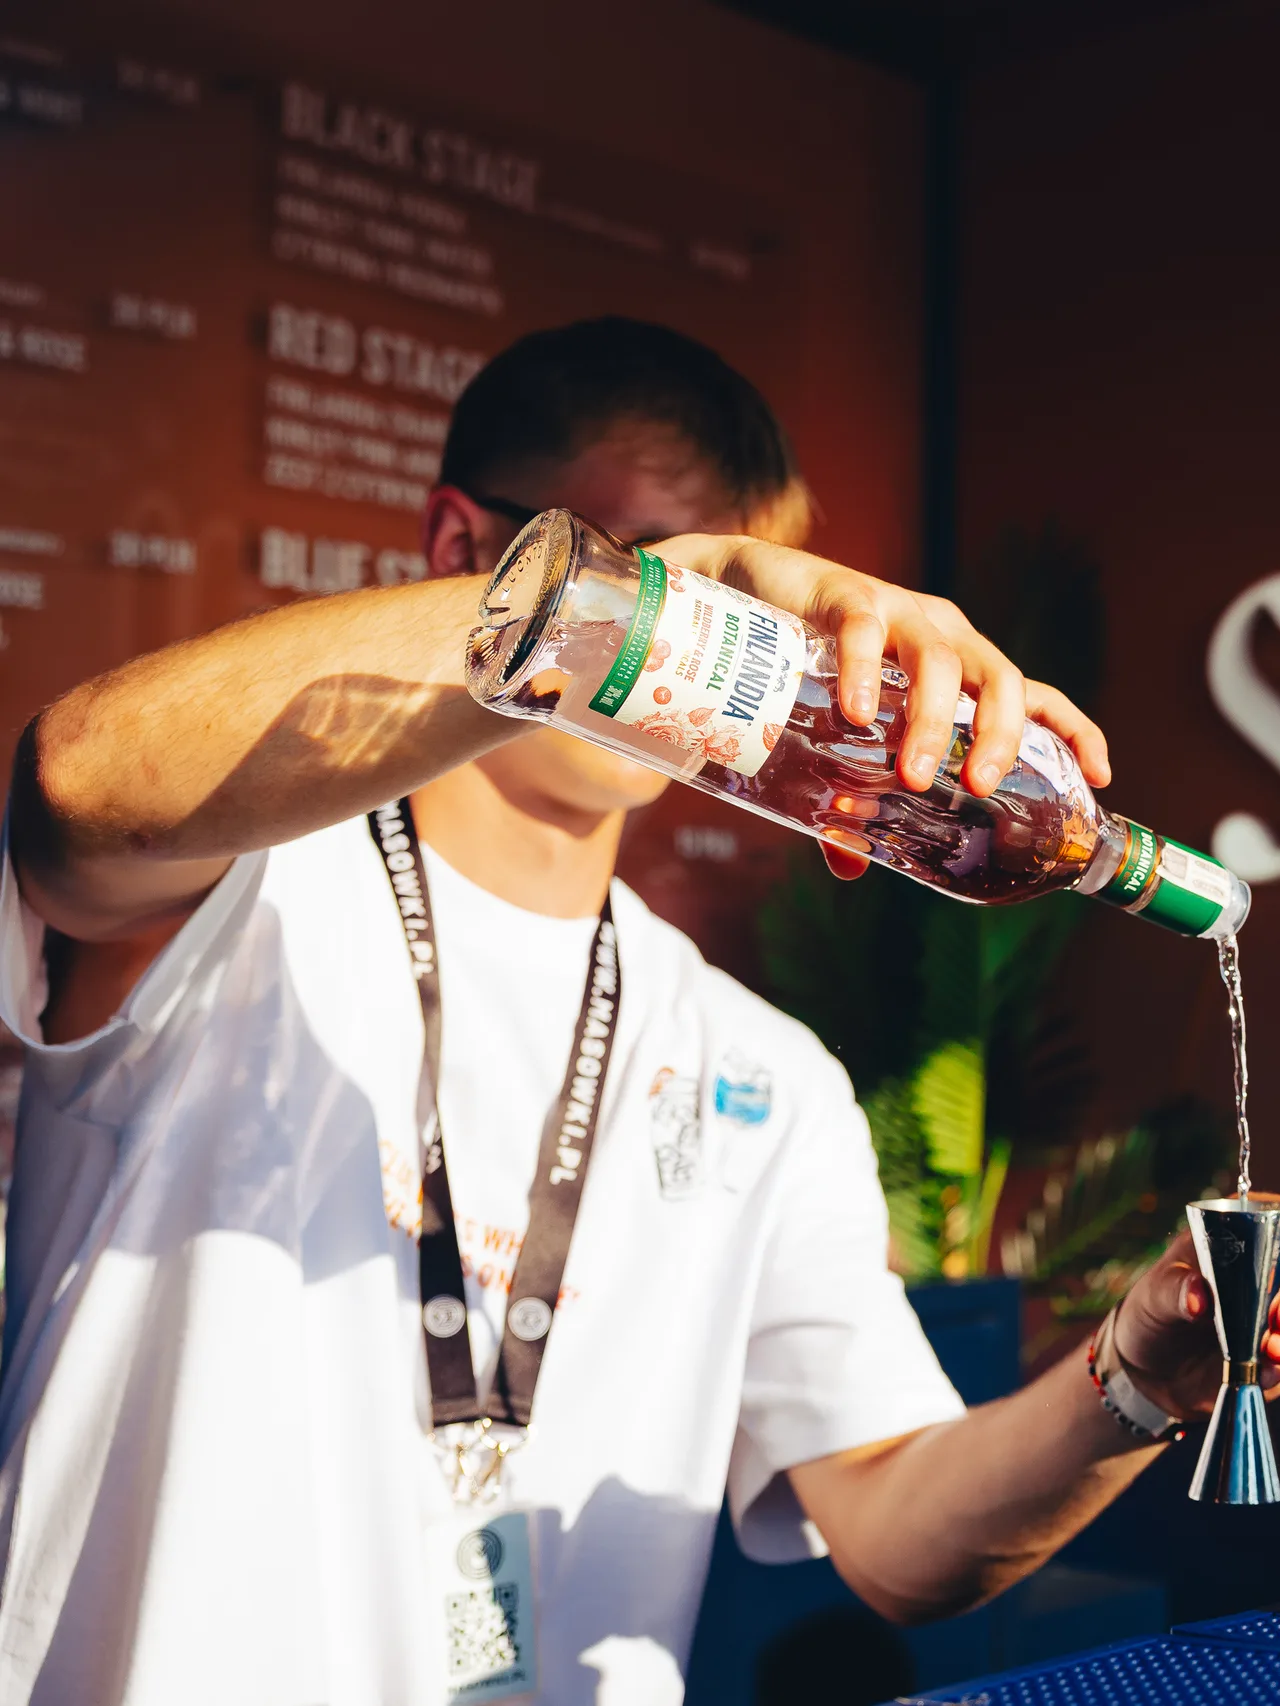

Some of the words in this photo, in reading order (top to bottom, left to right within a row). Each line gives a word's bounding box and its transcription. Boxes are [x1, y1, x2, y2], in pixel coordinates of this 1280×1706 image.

[282, 82, 414, 174] BLACK
[267, 301, 358, 378] RED
[362, 325, 487, 404] STAG
[693, 649, 704, 658] &
[696, 603, 714, 651] WILDBERRY
[705, 612, 740, 691] BOTANICAL
[684, 657, 701, 683] ROSE
[721, 610, 778, 722] FINLANDIA
[1123, 831, 1153, 893] BOTANICAL
